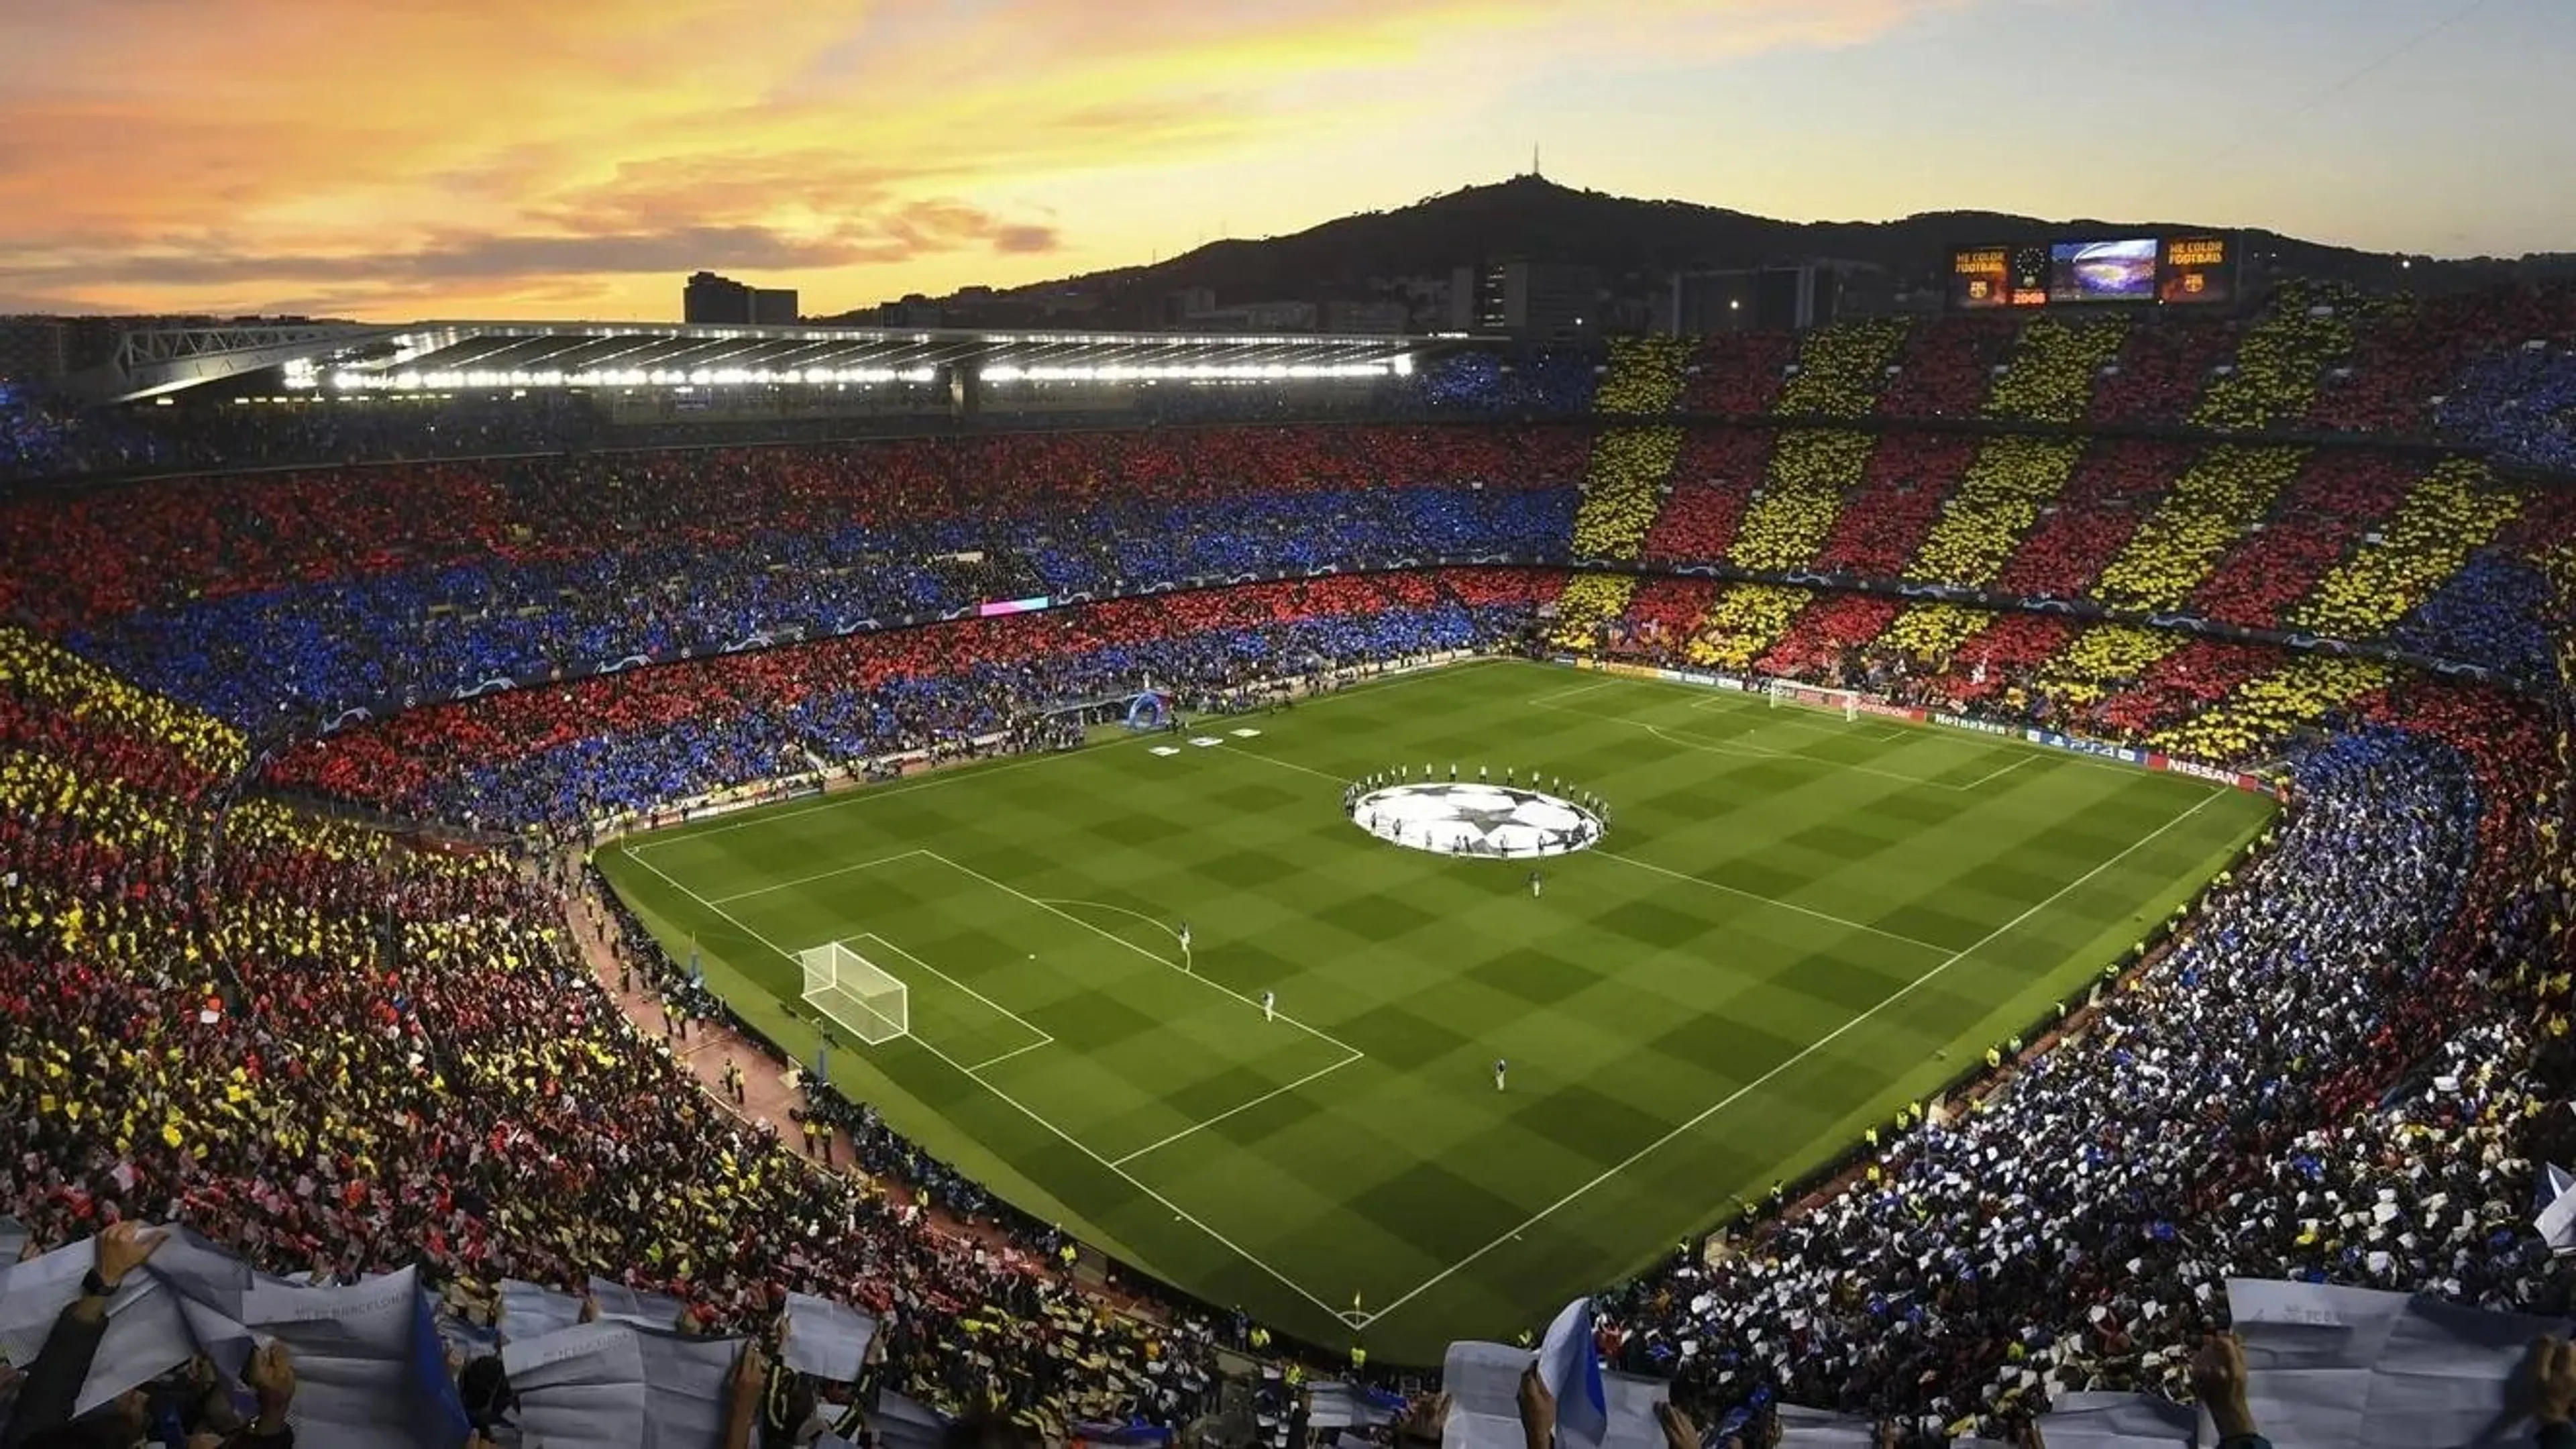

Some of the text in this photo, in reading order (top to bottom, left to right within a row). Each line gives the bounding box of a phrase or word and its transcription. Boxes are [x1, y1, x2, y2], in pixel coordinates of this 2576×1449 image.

[1935, 713, 2006, 735] Heineken
[2069, 741, 2114, 757] PS4
[2167, 757, 2240, 786] NISSAN
